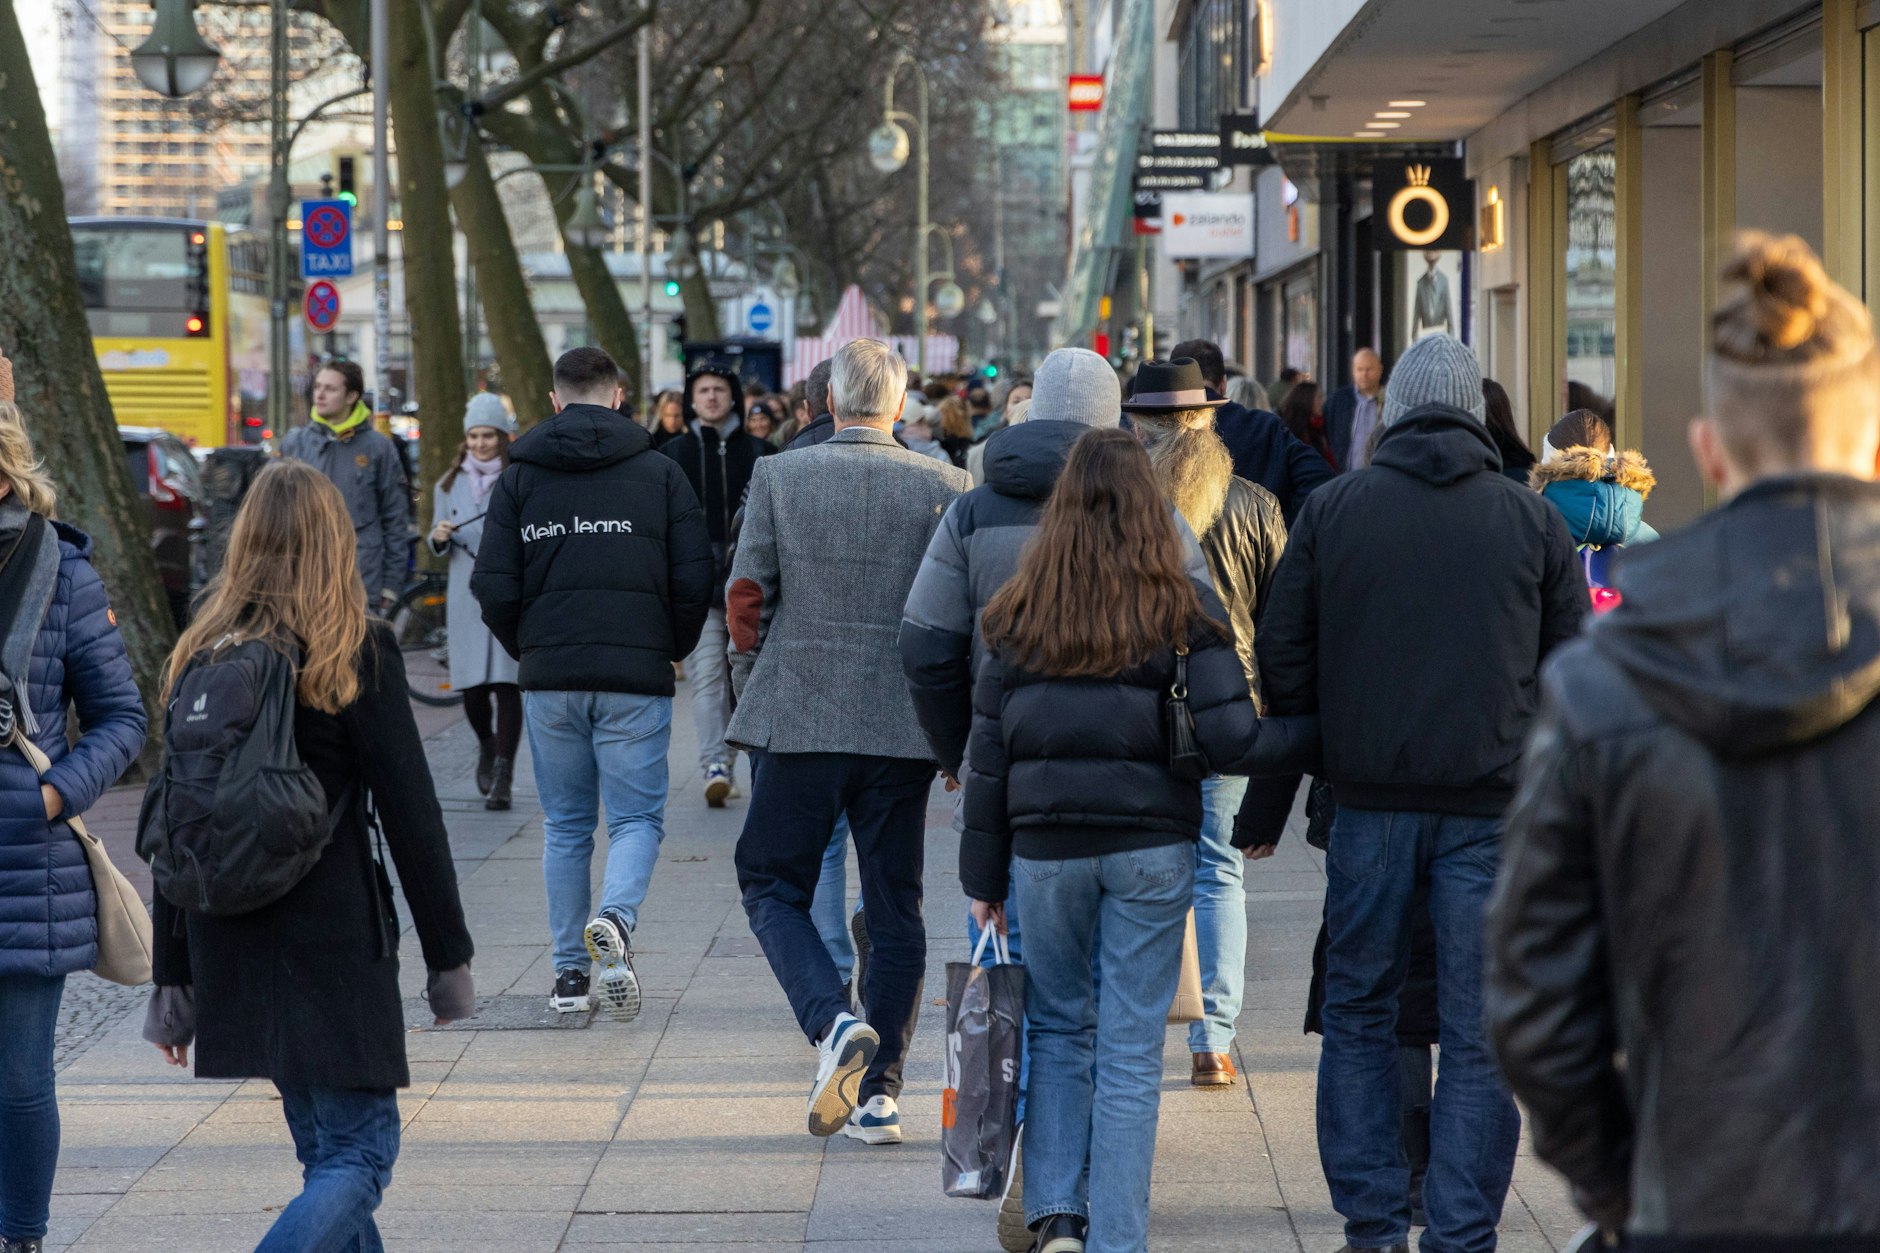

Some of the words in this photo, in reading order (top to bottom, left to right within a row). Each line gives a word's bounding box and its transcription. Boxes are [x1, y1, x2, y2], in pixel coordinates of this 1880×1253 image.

[1188, 213, 1245, 226] zalando
[306, 252, 350, 271] TAXI
[520, 521, 566, 543] Klein
